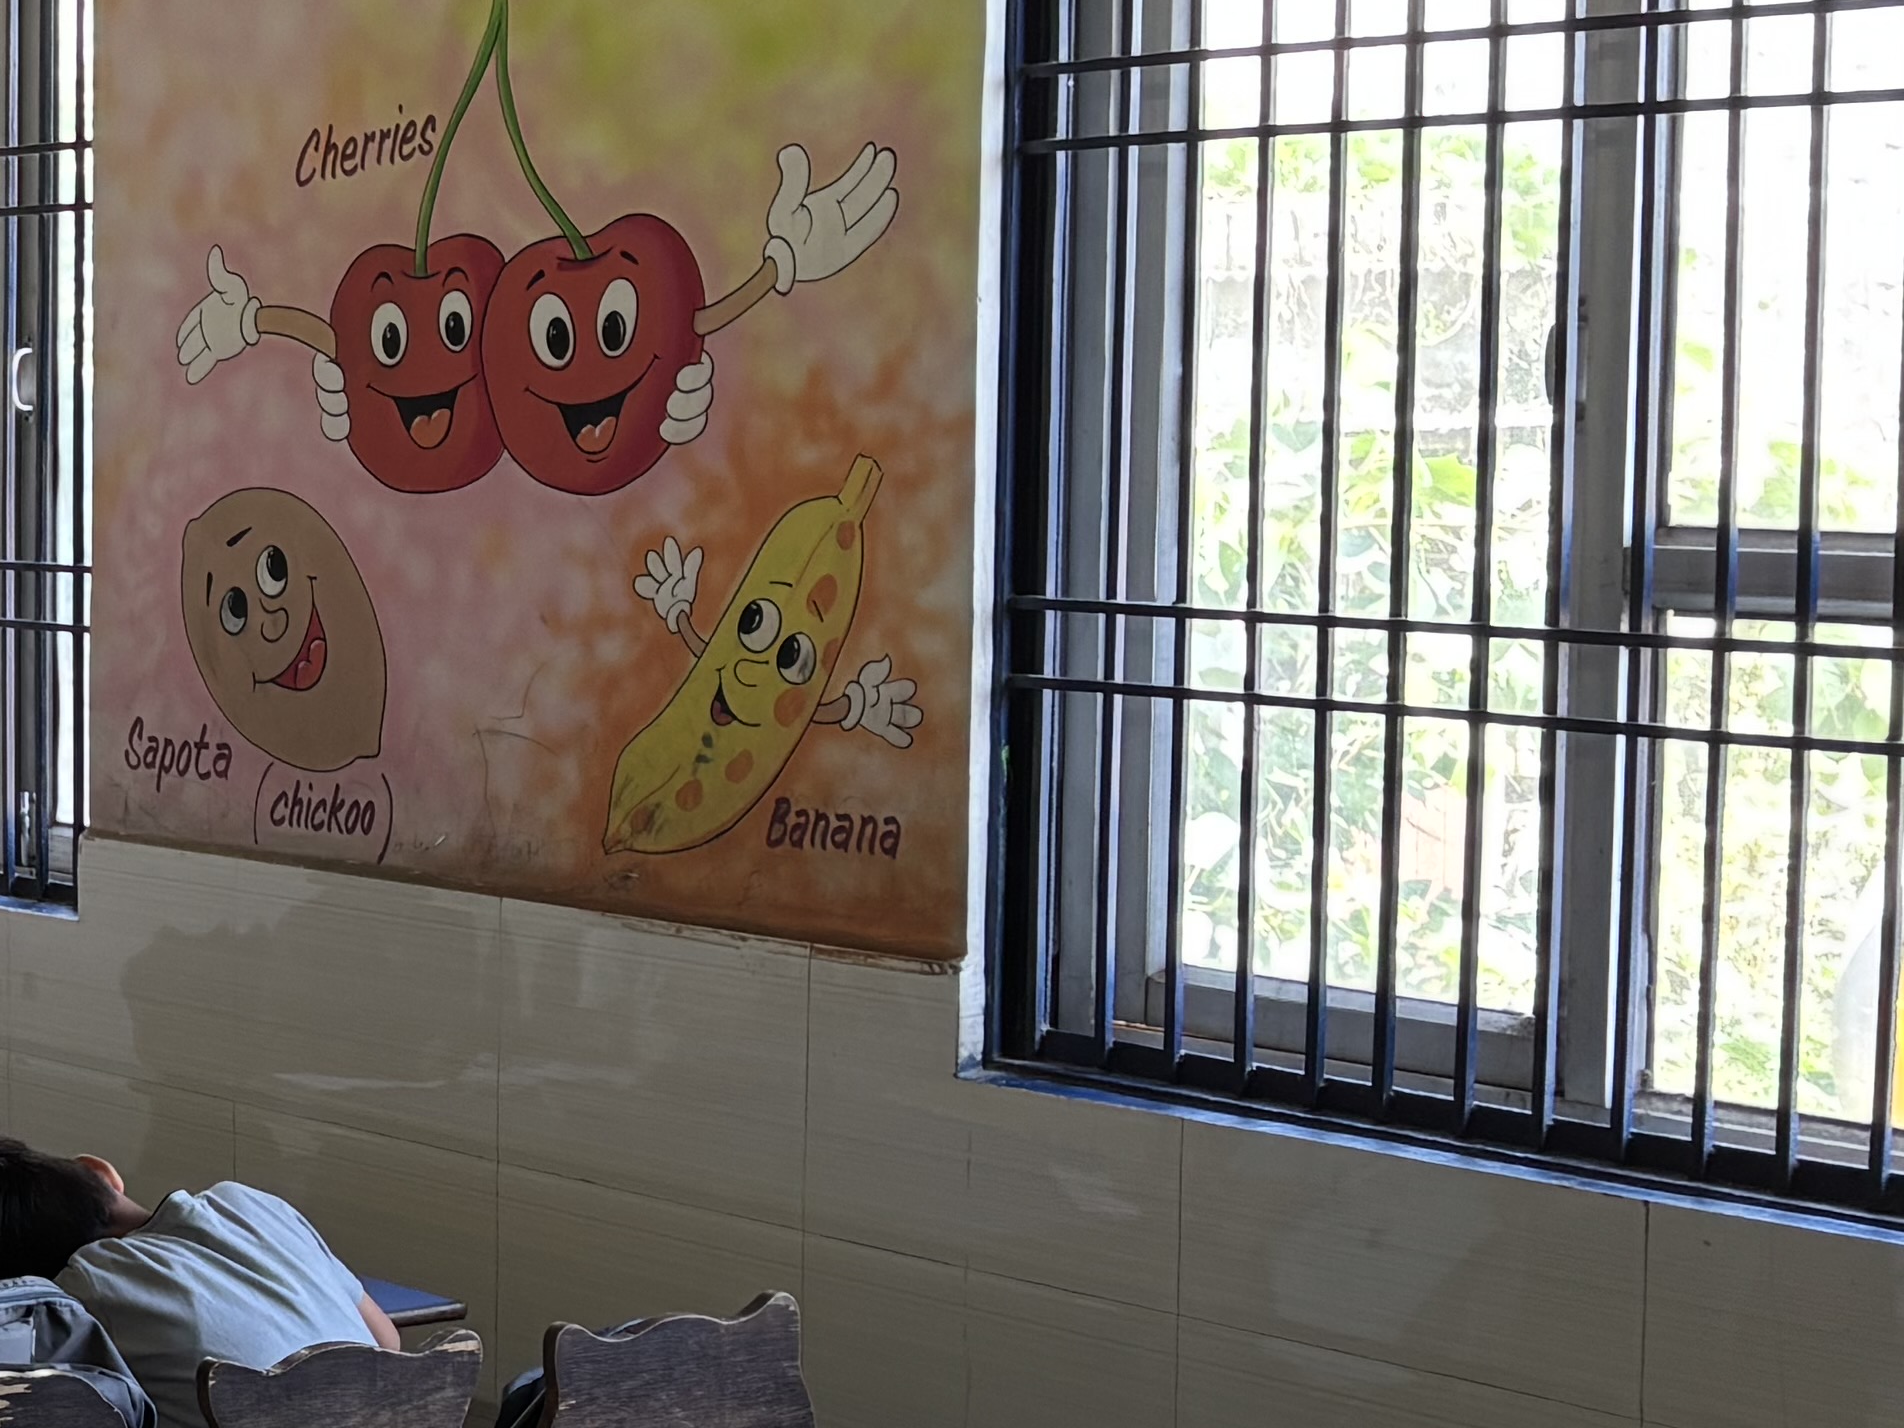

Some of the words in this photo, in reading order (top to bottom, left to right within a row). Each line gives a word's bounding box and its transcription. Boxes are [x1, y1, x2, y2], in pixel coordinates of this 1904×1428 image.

[294, 104, 438, 188] Cherries
[123, 716, 234, 793] Sapota
[765, 796, 902, 861] Banana
